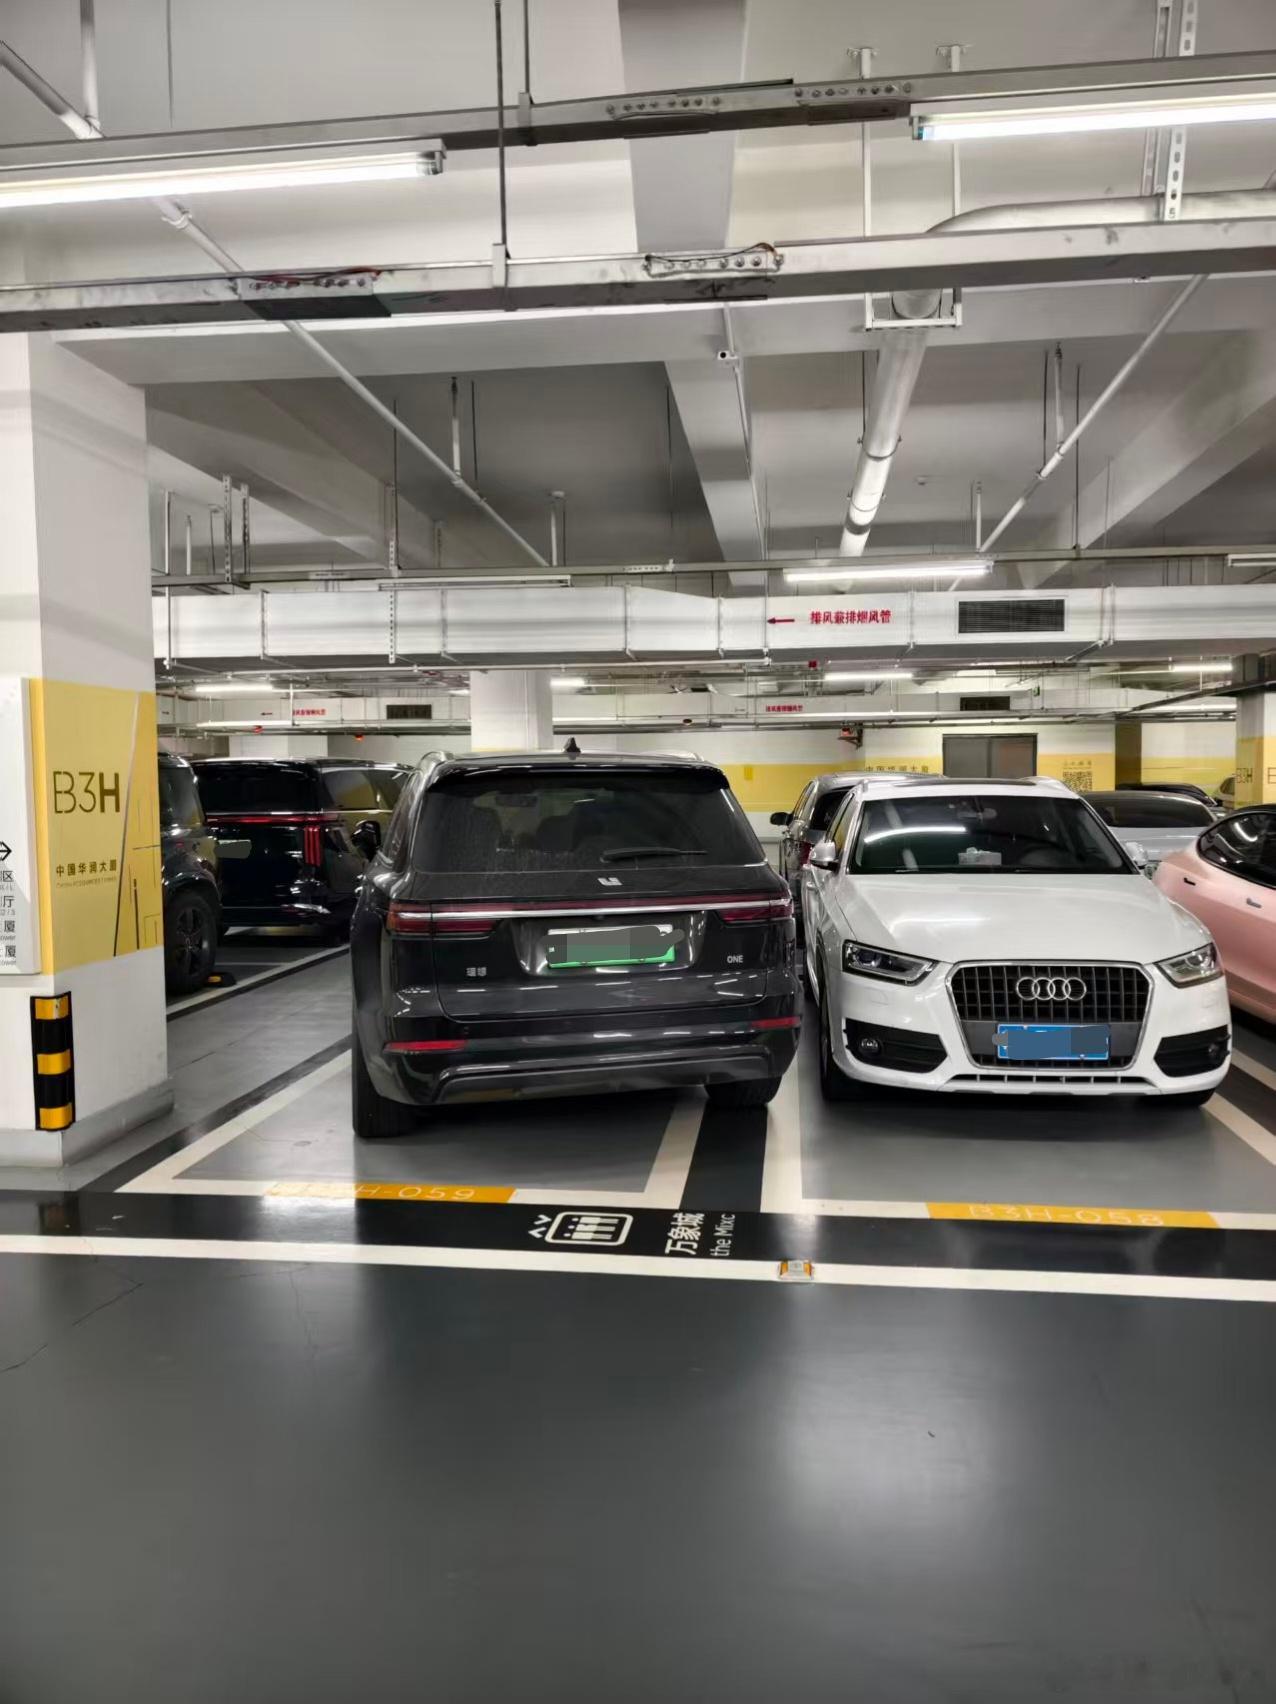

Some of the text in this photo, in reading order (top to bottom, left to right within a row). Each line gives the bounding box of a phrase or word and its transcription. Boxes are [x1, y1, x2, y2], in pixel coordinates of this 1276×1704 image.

[53, 771, 120, 814] B3H
[56, 859, 116, 877] 中国华润大厦
[727, 954, 744, 963] ONE
[664, 1212, 705, 1255] 万象城
[709, 1238, 732, 1256] the
